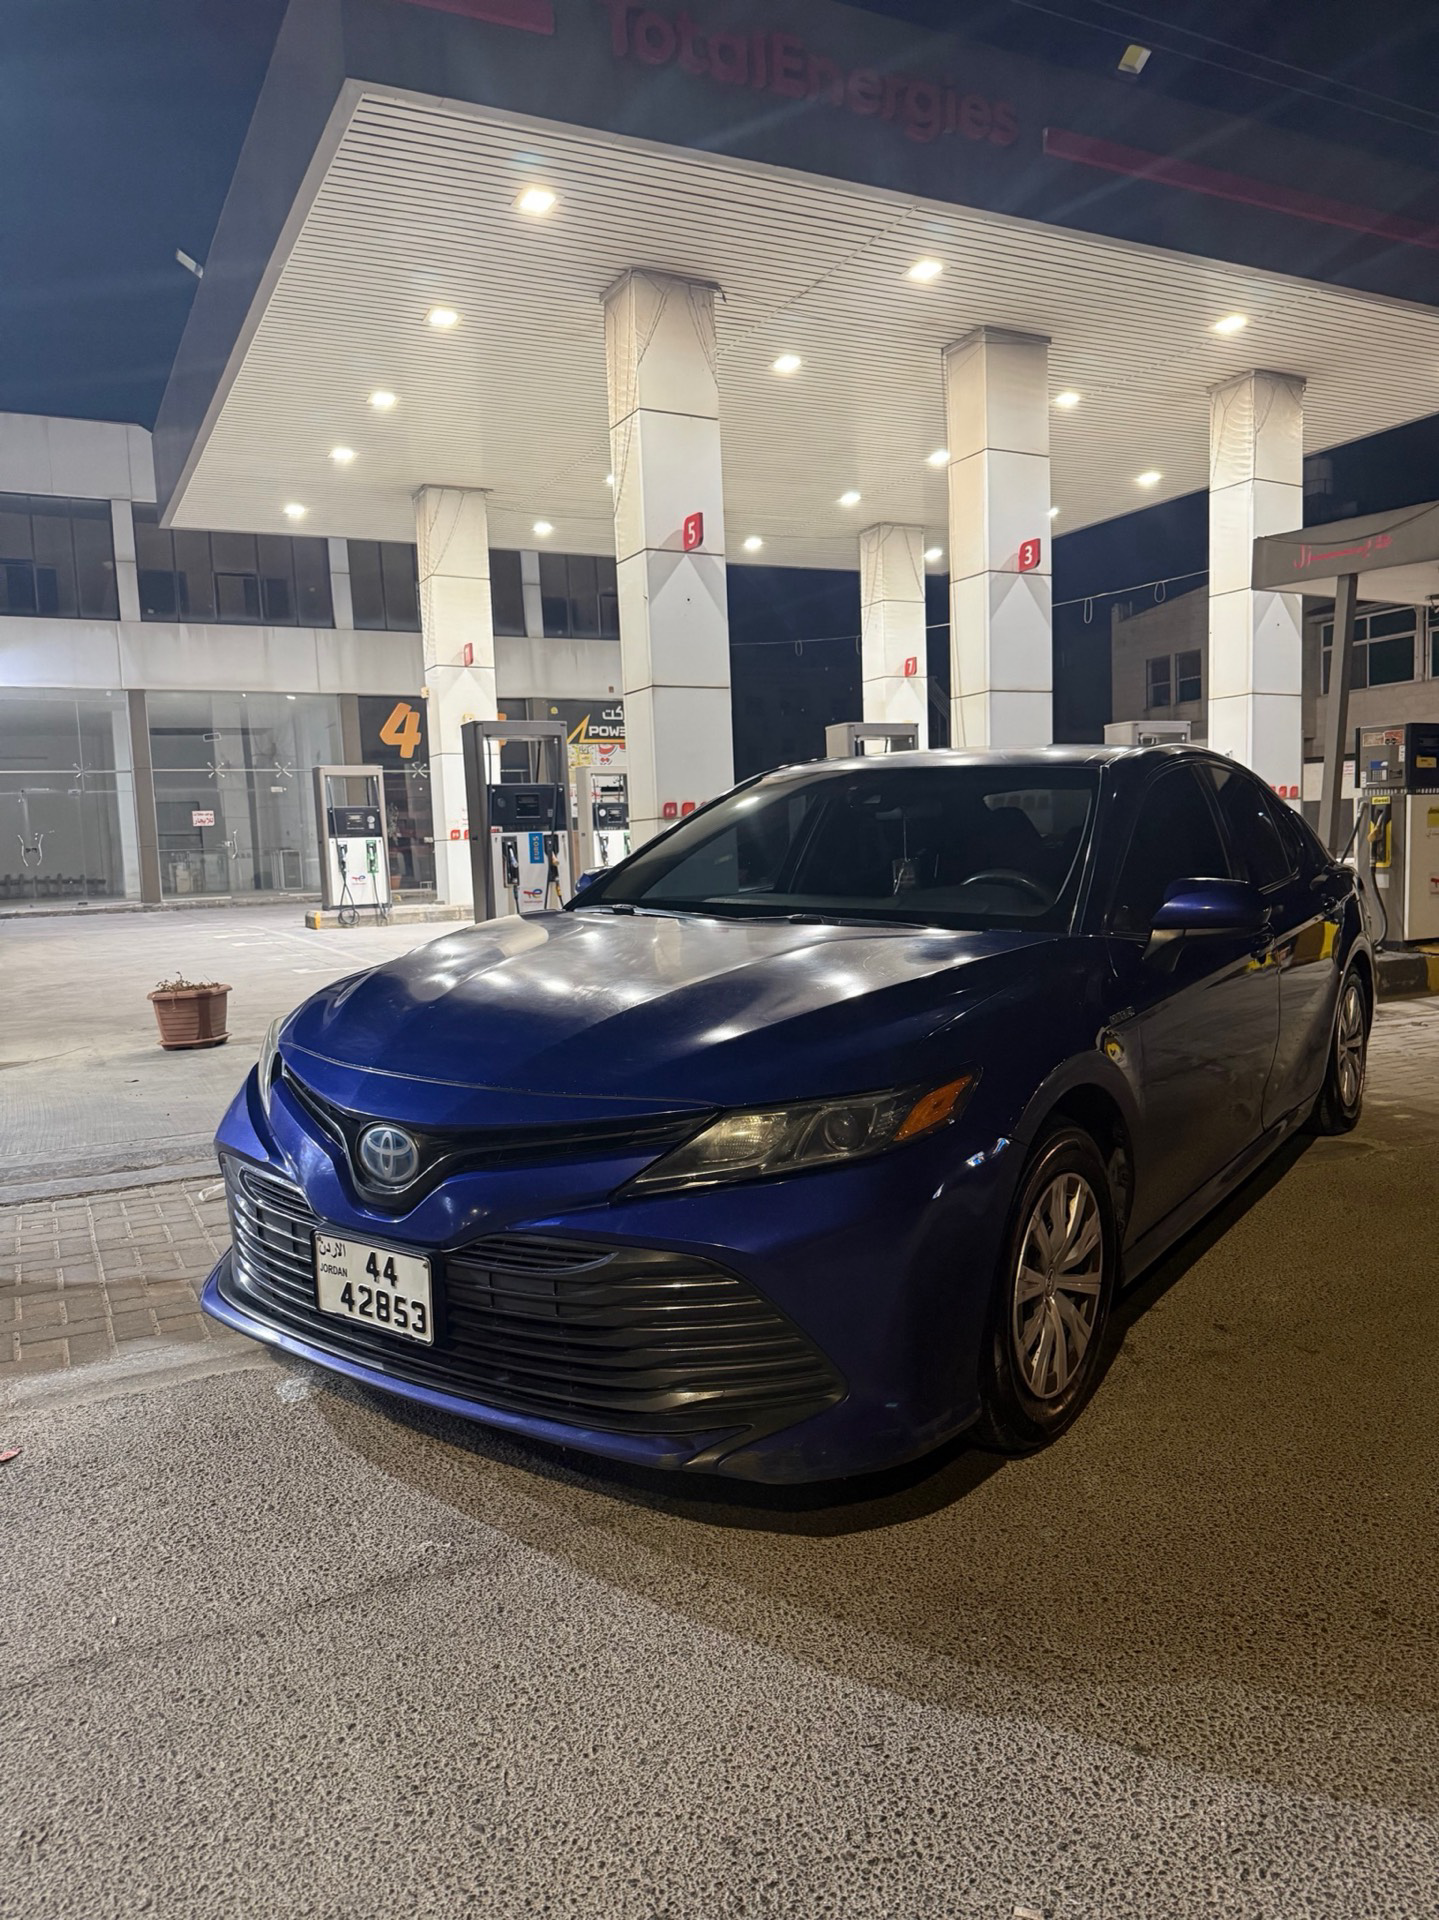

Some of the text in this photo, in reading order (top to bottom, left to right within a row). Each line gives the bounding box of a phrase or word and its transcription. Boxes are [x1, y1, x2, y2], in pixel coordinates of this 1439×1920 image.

[603, 0, 1020, 147] TotalEnergies
[687, 521, 697, 545] 5
[1023, 545, 1033, 565] 3
[379, 702, 422, 759] 4
[320, 1262, 348, 1278] JORDAN
[366, 1251, 398, 1287] 44
[340, 1281, 427, 1334] 42853
